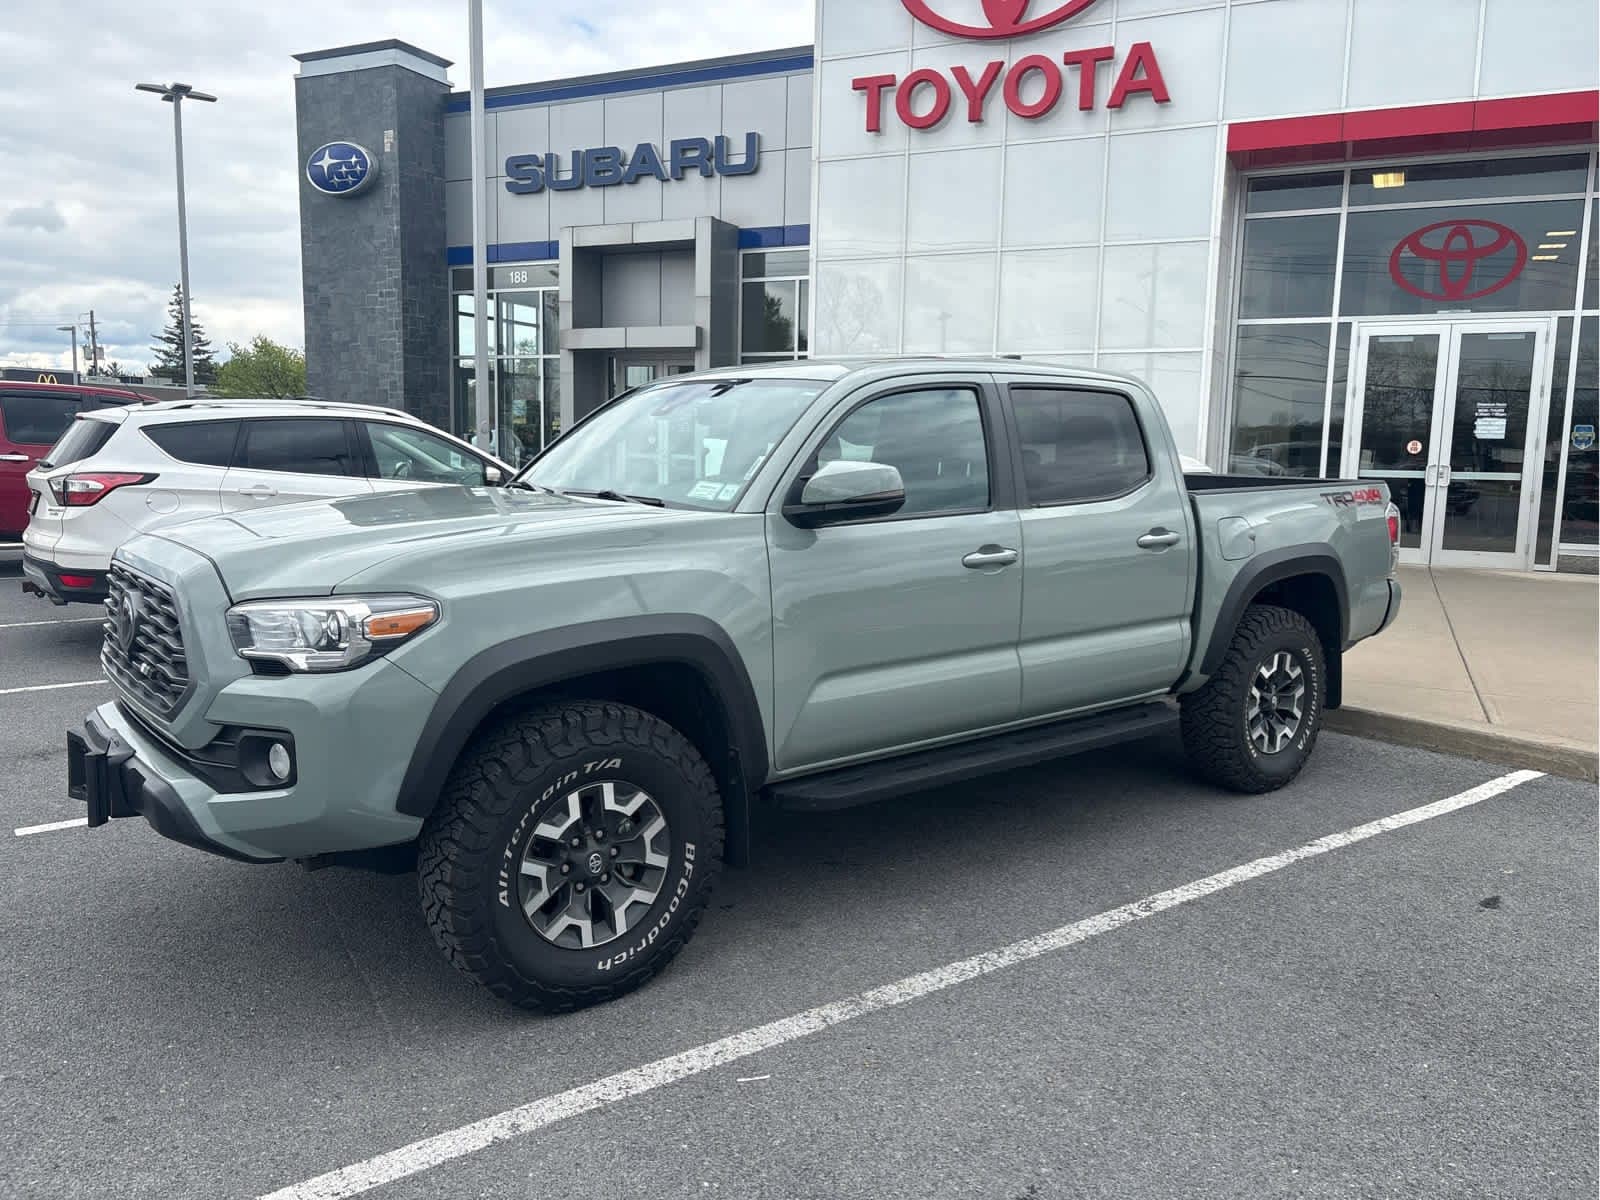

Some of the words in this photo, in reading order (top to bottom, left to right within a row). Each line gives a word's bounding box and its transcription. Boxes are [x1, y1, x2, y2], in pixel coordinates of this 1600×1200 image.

[852, 41, 1171, 133] TOYOTA
[505, 131, 761, 195] SUBARU
[510, 271, 528, 284] 188
[1320, 491, 1354, 507] TRD
[499, 769, 579, 908] All-Terrain
[583, 757, 623, 775] T/A
[597, 841, 697, 972] BFGoodrich
